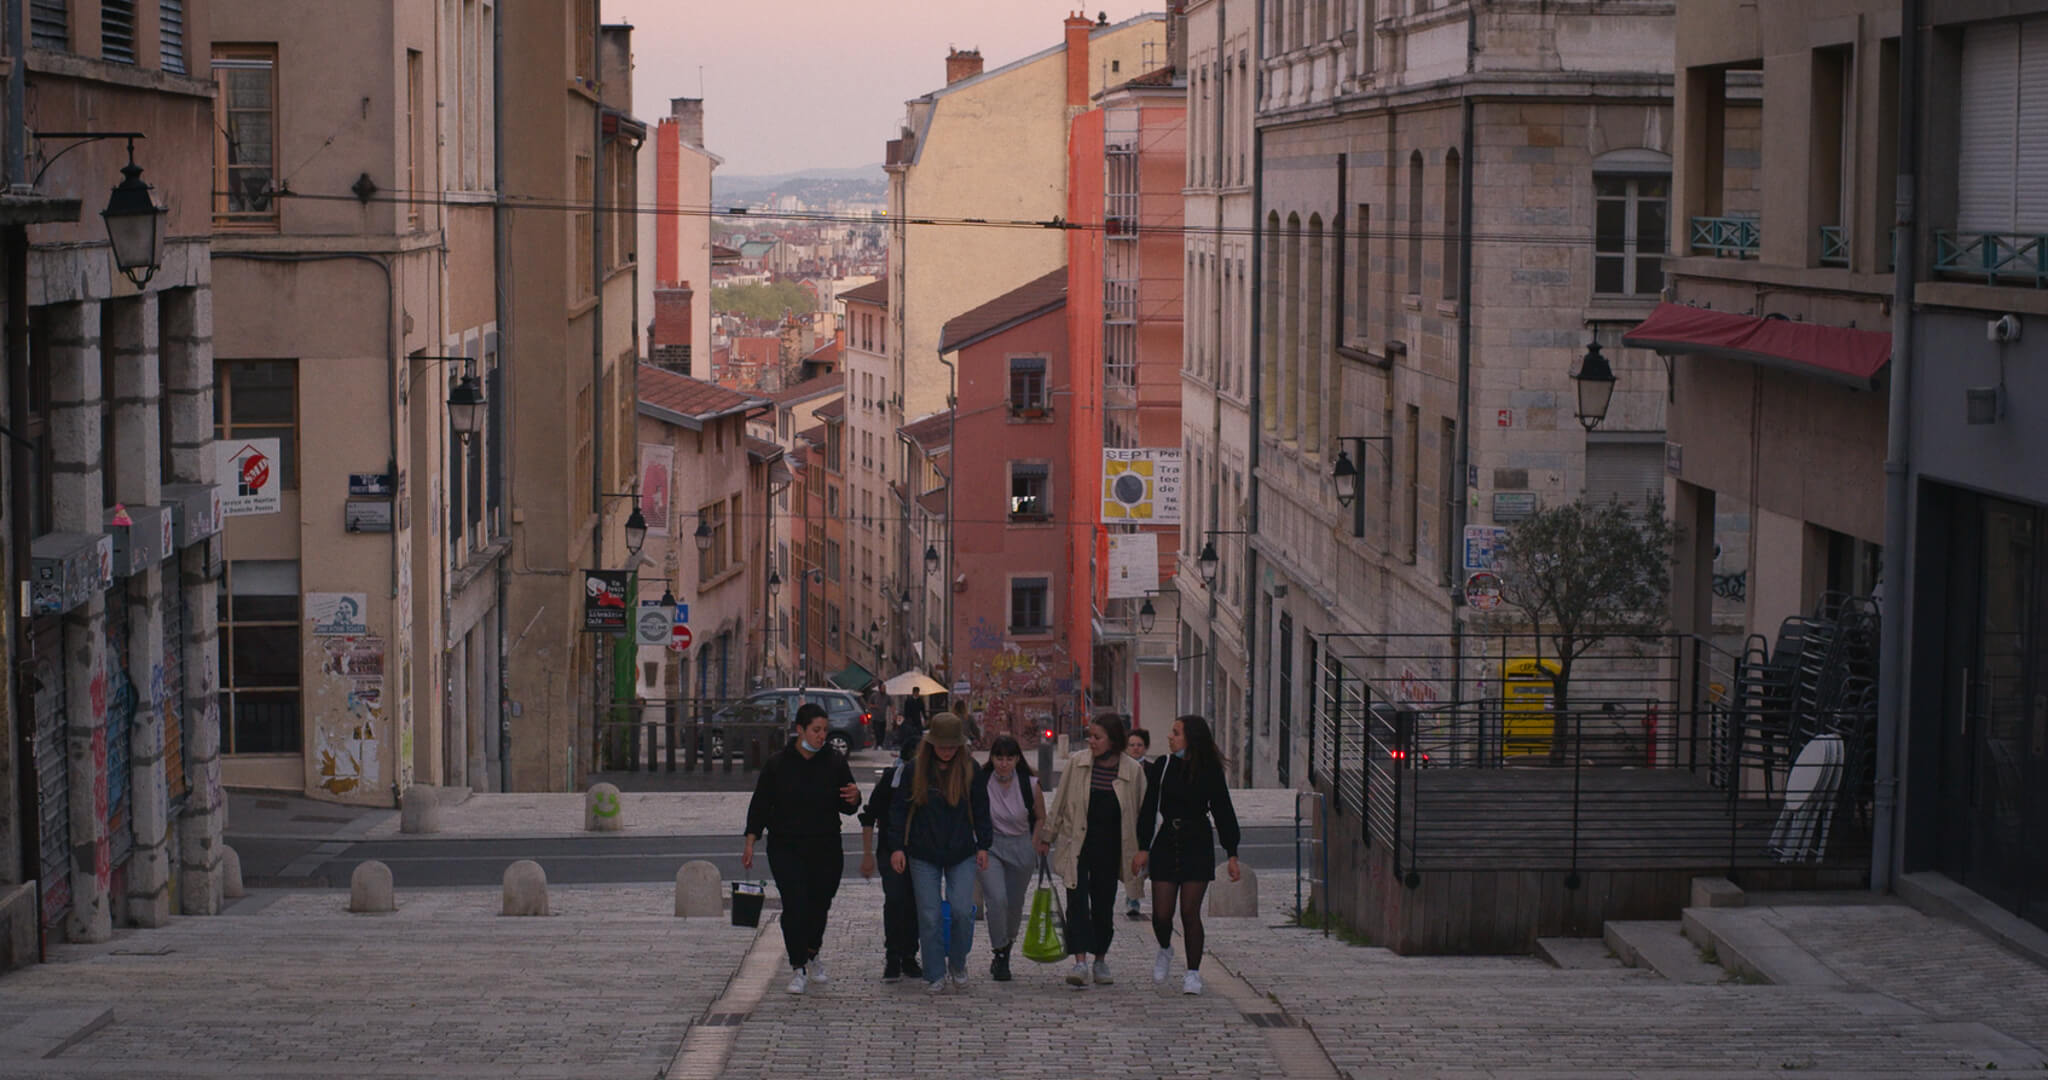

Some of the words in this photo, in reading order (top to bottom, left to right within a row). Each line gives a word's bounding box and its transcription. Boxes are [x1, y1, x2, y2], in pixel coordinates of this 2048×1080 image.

[1105, 450, 1152, 460] SEPT
[1160, 476, 1180, 484] tec
[1159, 484, 1175, 493] de
